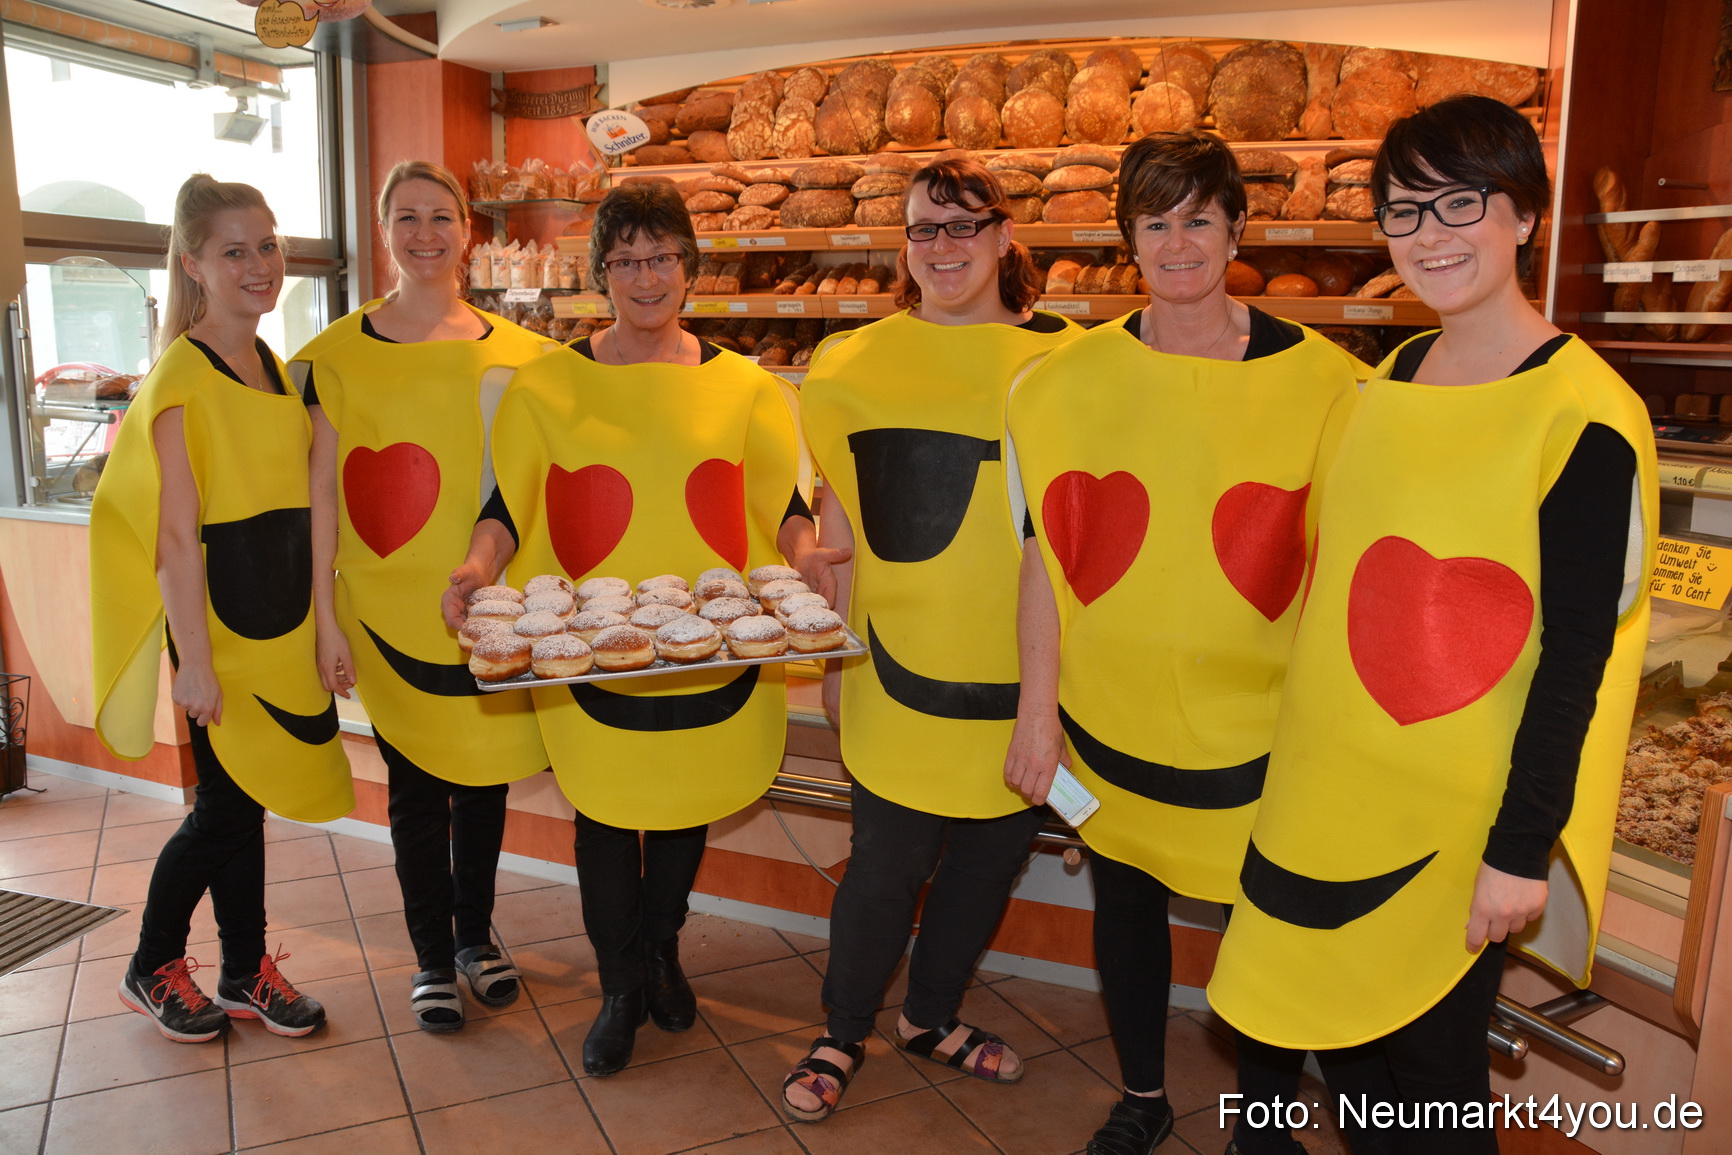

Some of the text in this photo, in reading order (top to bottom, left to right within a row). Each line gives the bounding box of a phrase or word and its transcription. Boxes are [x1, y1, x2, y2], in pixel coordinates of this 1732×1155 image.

[546, 103, 569, 116] 1847
[591, 114, 627, 133] WIR BACKEN
[1672, 476, 1695, 487] 1.10 €
[1656, 541, 1712, 560] denken Sie
[1659, 553, 1698, 570] Umwelt
[1653, 567, 1703, 586] ommen Sie
[1648, 579, 1712, 602] für 10 Cent
